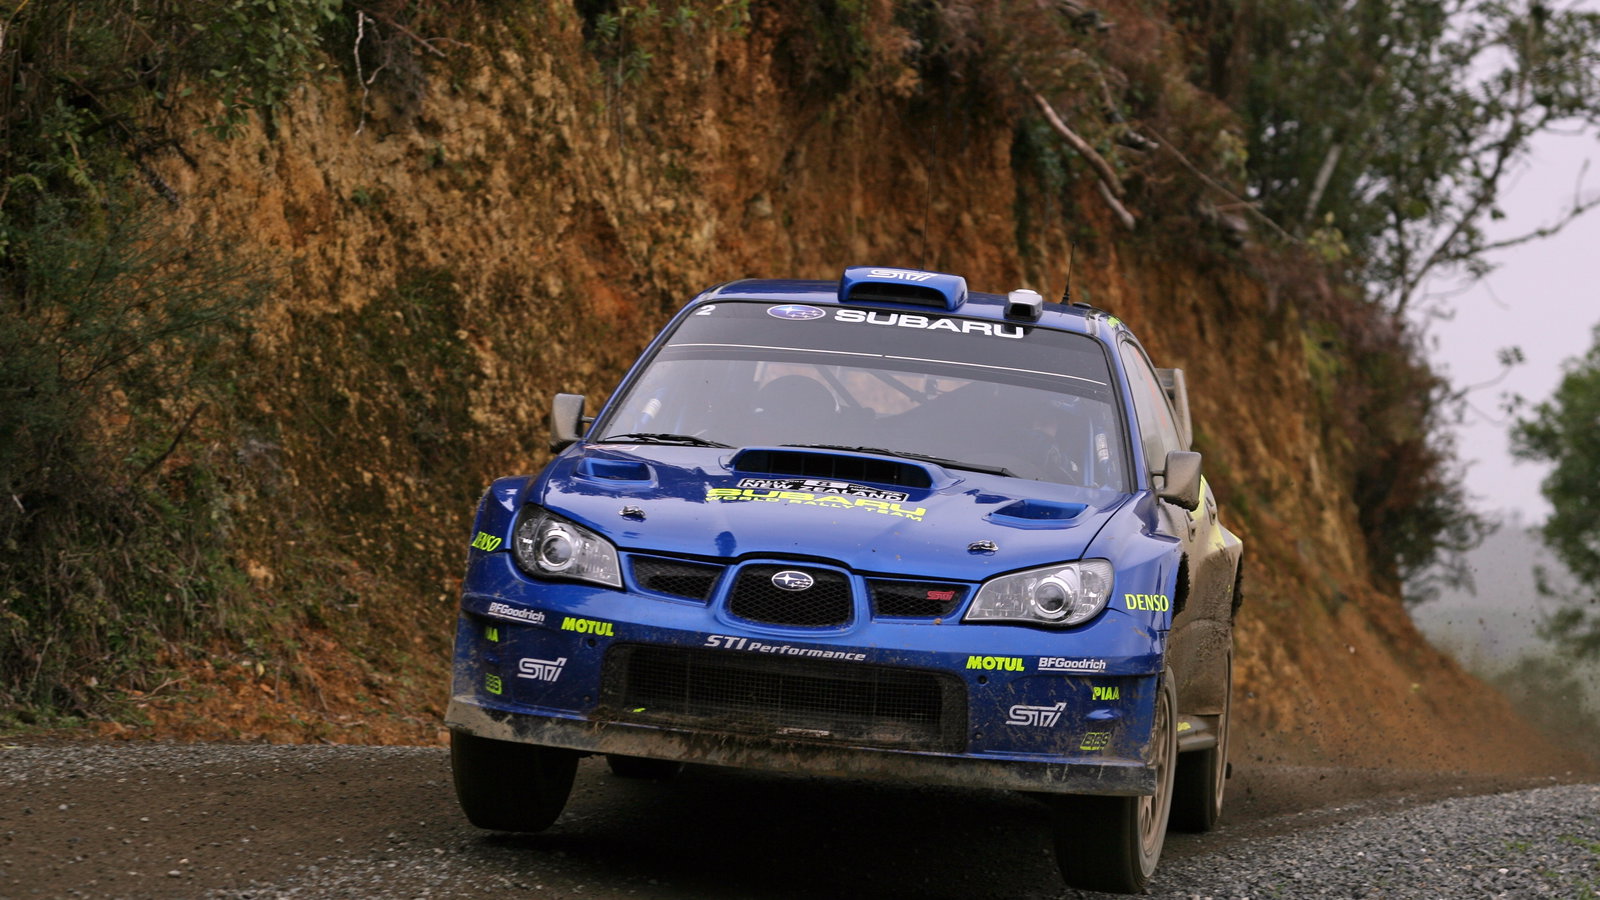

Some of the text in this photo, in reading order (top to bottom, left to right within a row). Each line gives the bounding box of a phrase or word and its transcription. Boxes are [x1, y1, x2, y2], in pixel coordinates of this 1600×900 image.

[695, 305, 716, 316] 2
[834, 309, 1024, 339] SUBARU
[742, 482, 793, 490] NEW
[799, 486, 902, 501] ZEALAND
[707, 487, 927, 517] SUBARU
[788, 500, 855, 509] RALLY
[865, 507, 922, 522] TEAM
[488, 602, 545, 622] BFGoodrich
[1125, 593, 1169, 612] DENSO
[561, 617, 615, 637] MOTUL
[704, 635, 866, 661] STI Performance
[965, 656, 1025, 671] MOTUL
[1038, 657, 1106, 671] BFGoodrich
[1092, 686, 1120, 700] PIAA
